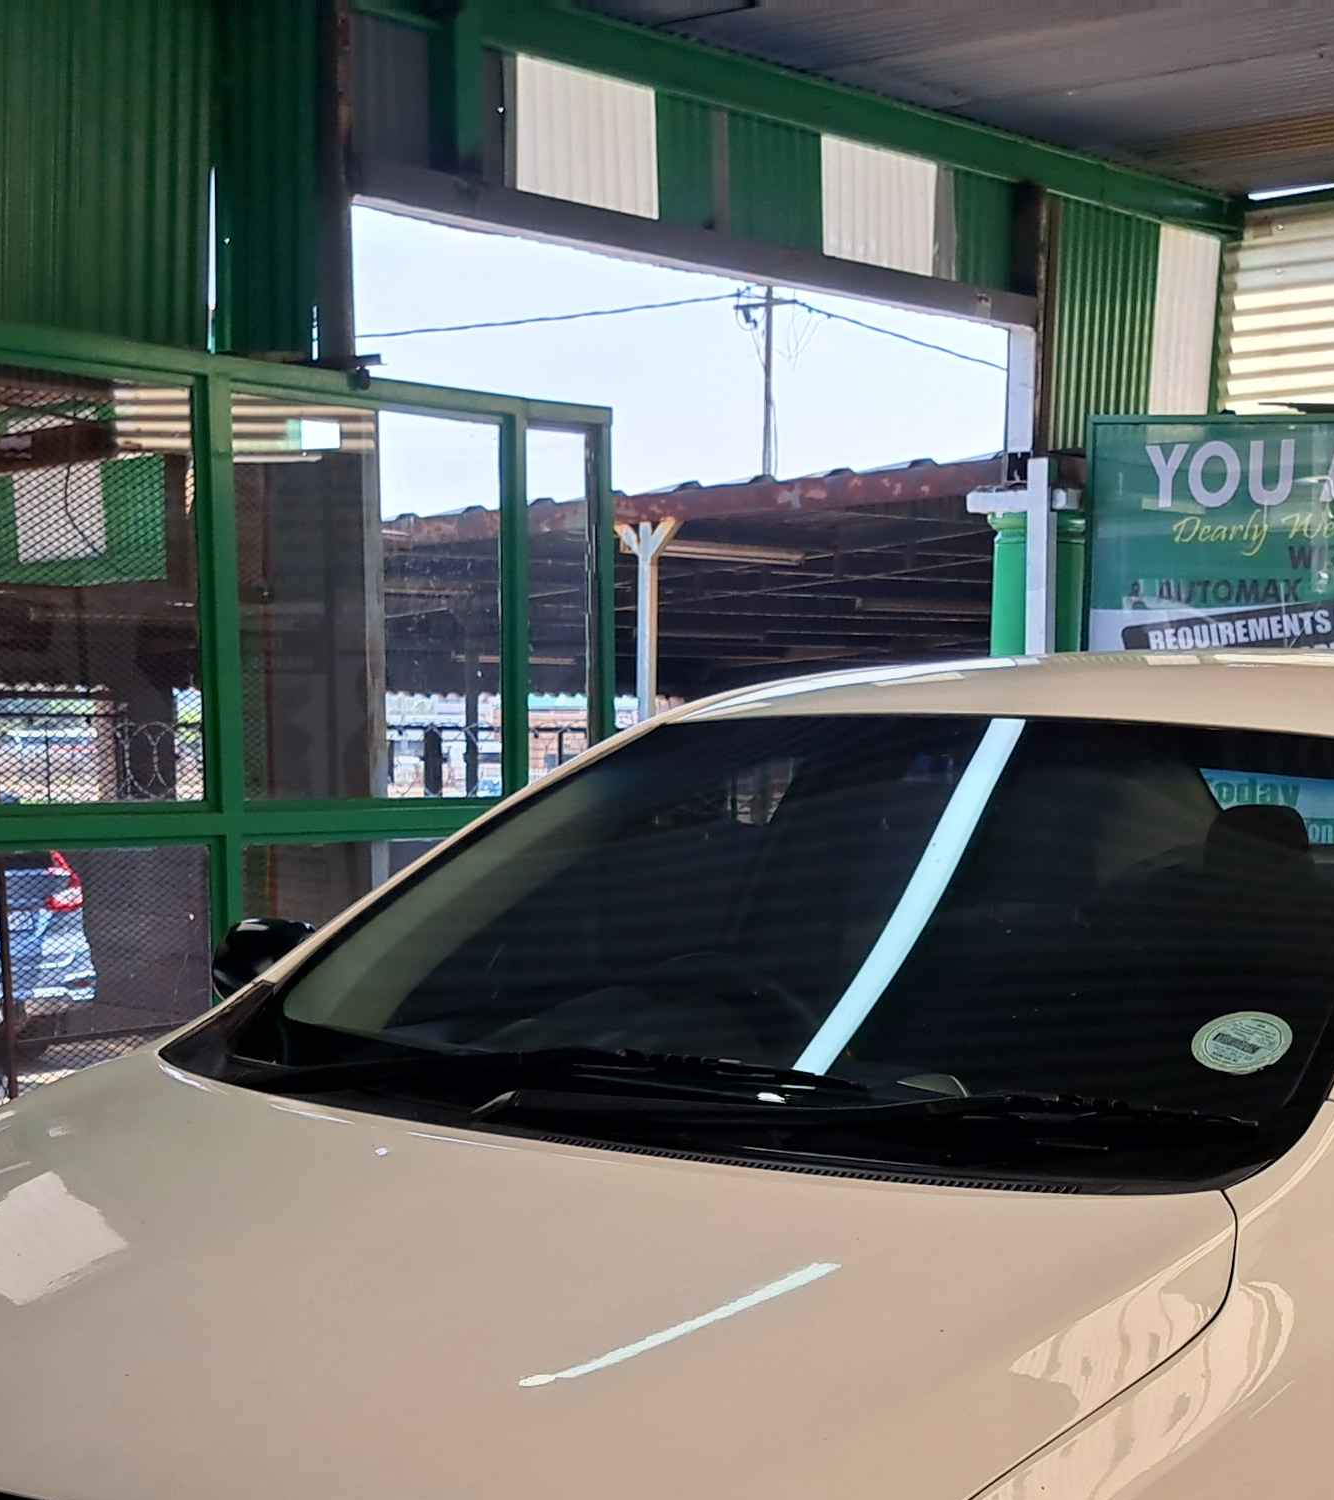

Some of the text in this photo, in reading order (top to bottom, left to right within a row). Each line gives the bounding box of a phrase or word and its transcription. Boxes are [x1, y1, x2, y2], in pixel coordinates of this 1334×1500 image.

[1145, 438, 1296, 508] YOU
[1172, 508, 1269, 556] Dearly
[1158, 578, 1302, 605] AUTOMAX
[1148, 608, 1332, 651] REQUIREMENTS
